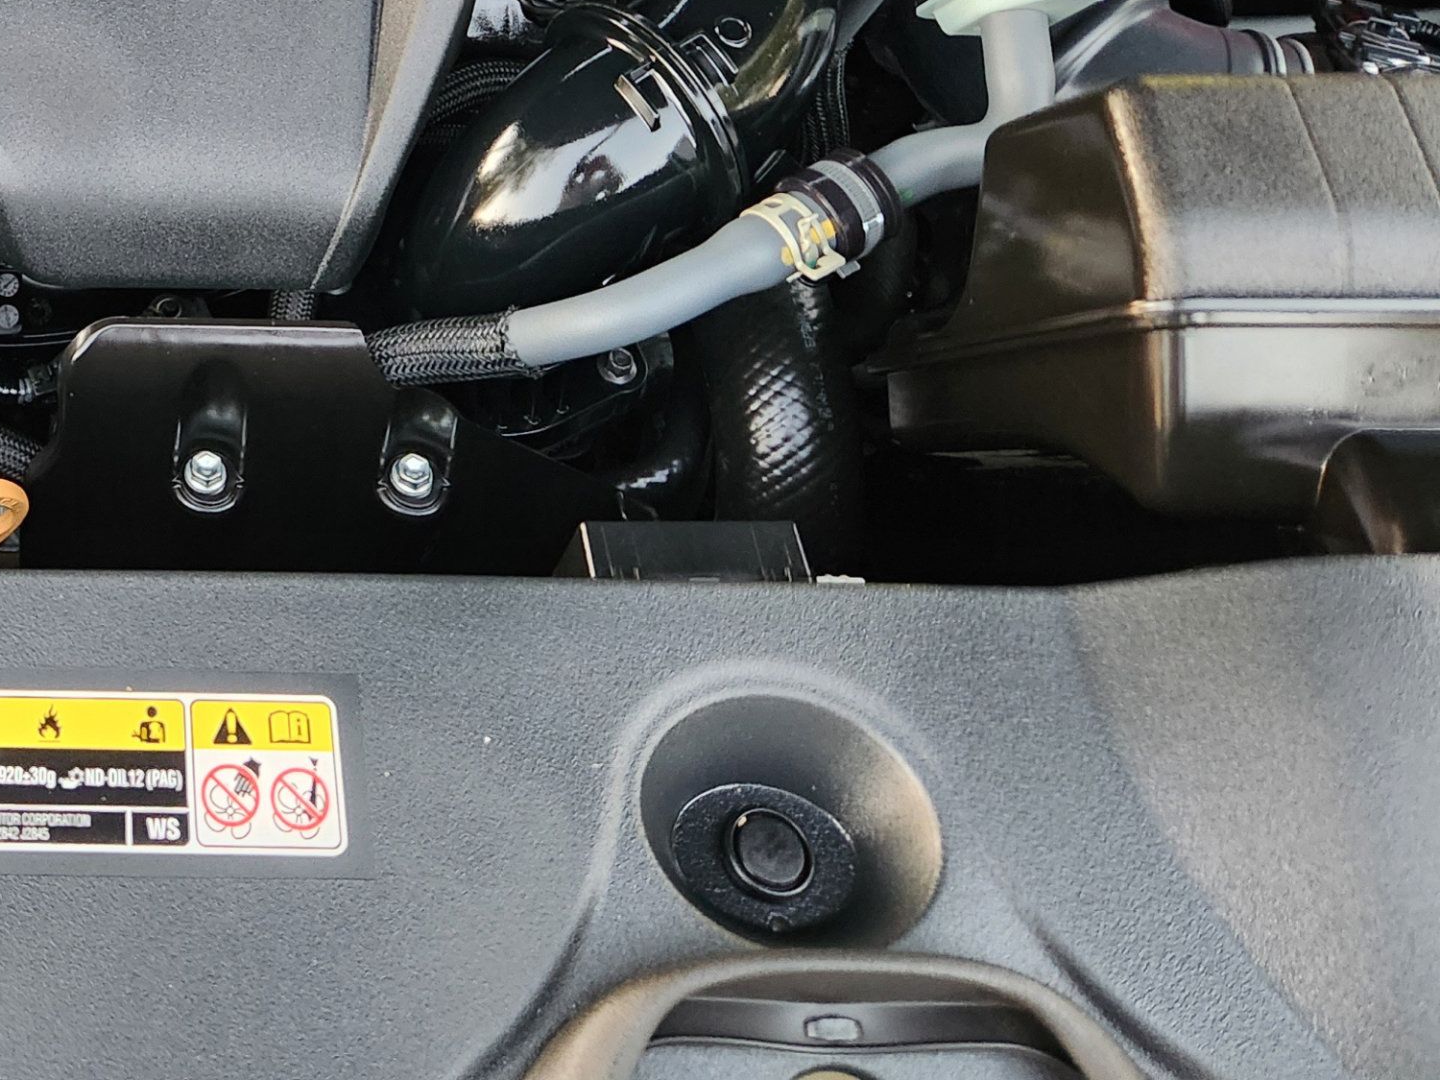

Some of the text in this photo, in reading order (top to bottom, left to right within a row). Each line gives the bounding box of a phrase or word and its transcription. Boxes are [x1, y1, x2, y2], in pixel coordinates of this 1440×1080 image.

[145, 769, 184, 791] (PAG)
[21, 812, 92, 827] CORPORATION
[145, 816, 182, 841] WS
